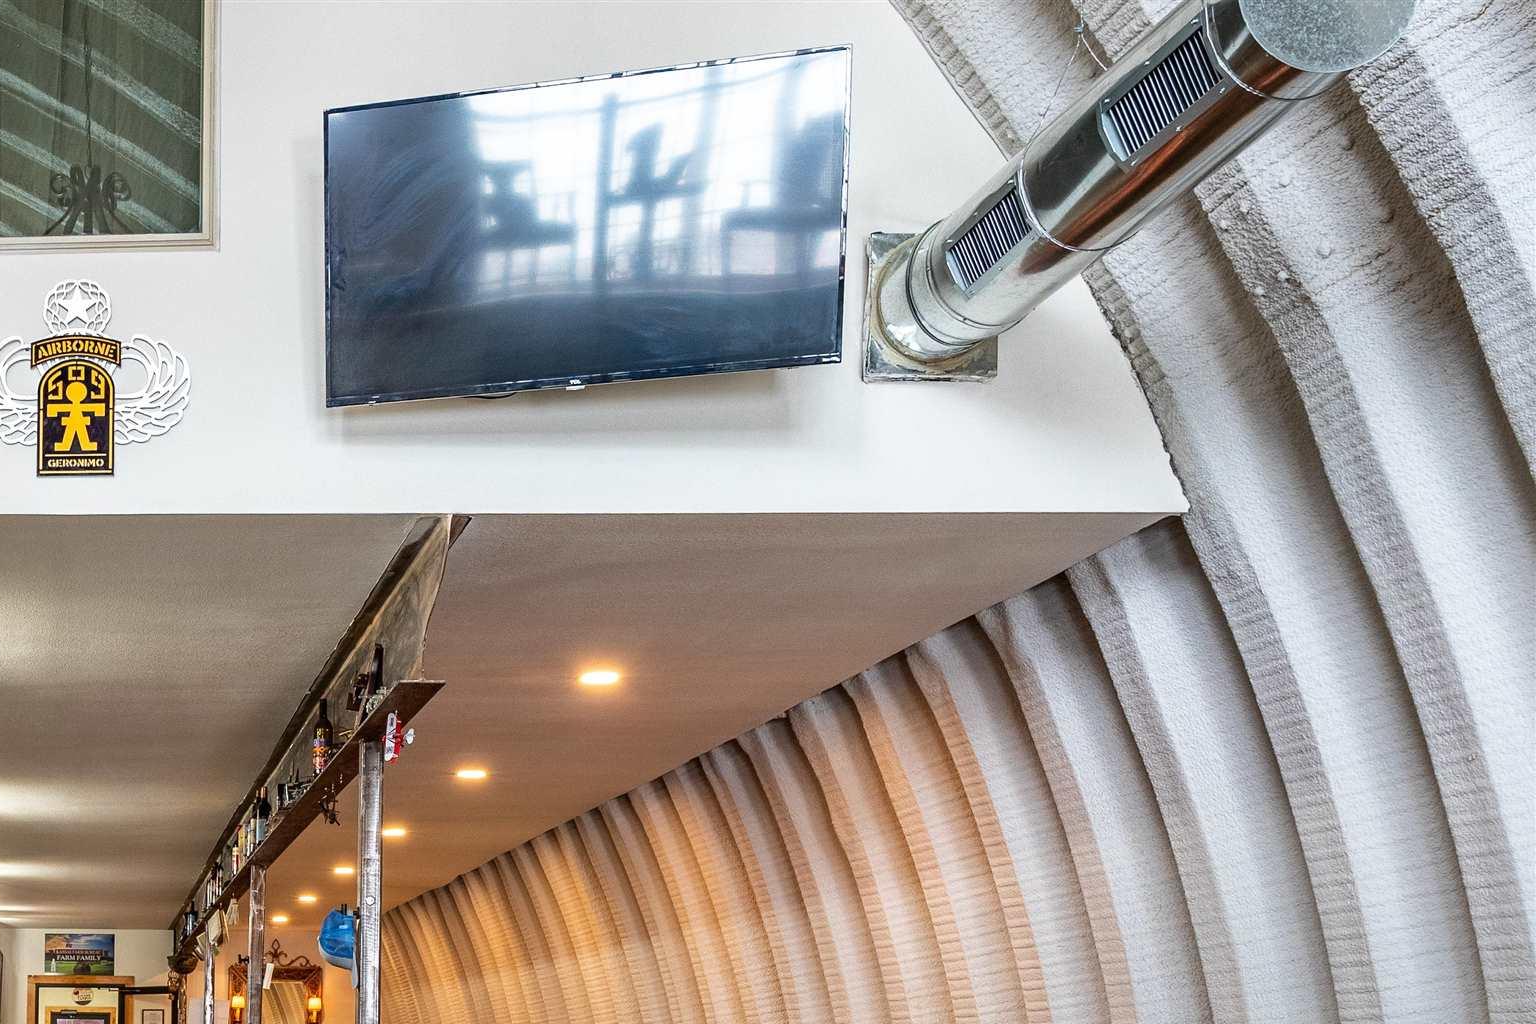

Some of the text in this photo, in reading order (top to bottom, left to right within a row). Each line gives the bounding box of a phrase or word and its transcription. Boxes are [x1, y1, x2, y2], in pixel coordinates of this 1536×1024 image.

[38, 340, 117, 359] AIRBORNE
[47, 365, 106, 400] 509
[47, 458, 106, 468] GERONIMO
